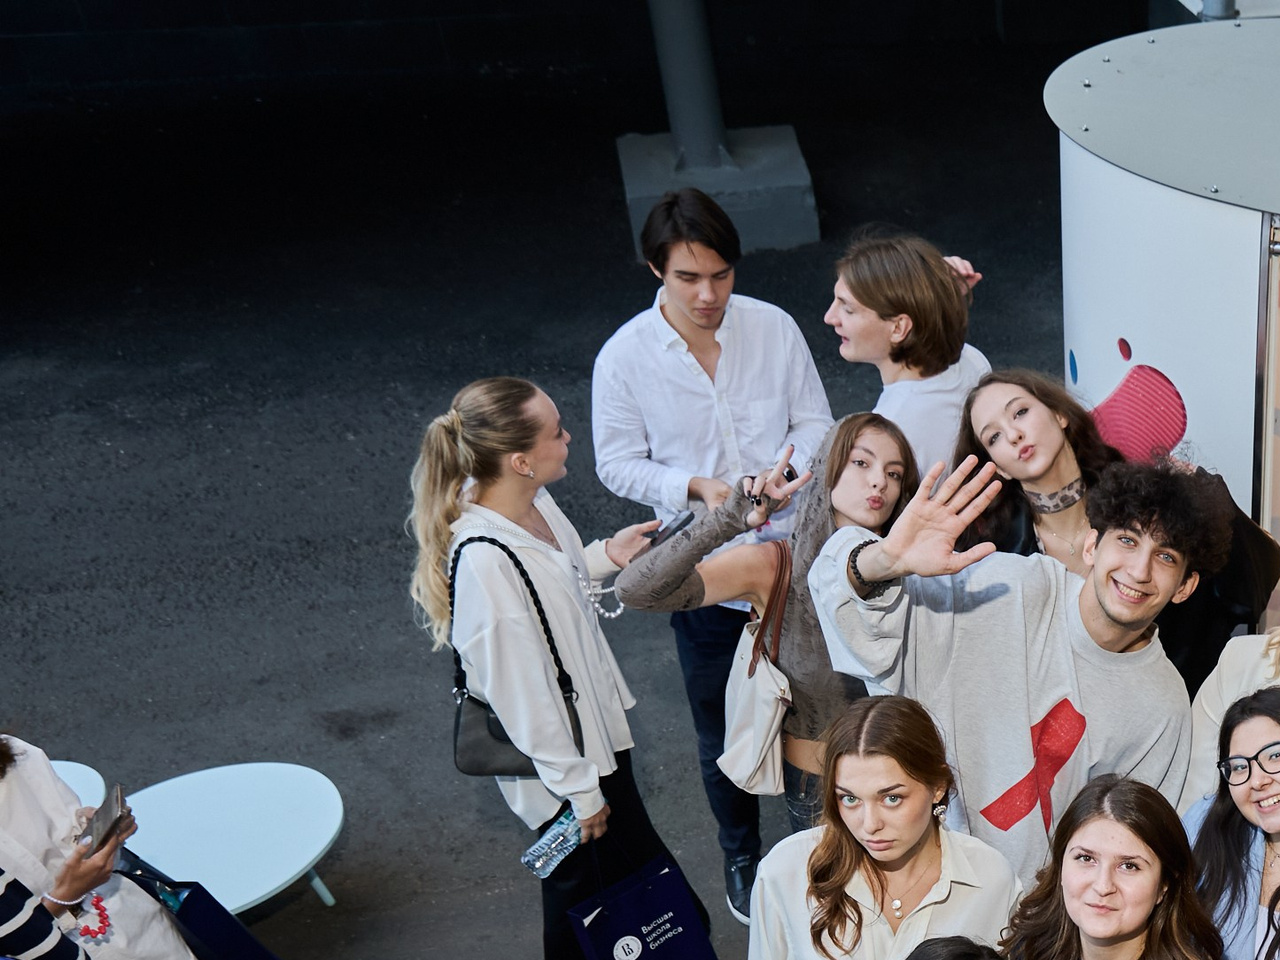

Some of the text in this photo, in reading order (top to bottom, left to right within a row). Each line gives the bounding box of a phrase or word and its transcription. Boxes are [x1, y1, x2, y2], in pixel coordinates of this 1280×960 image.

[641, 911, 674, 934] Высшая
[645, 922, 671, 942] школа
[649, 926, 683, 950] бизнеса
